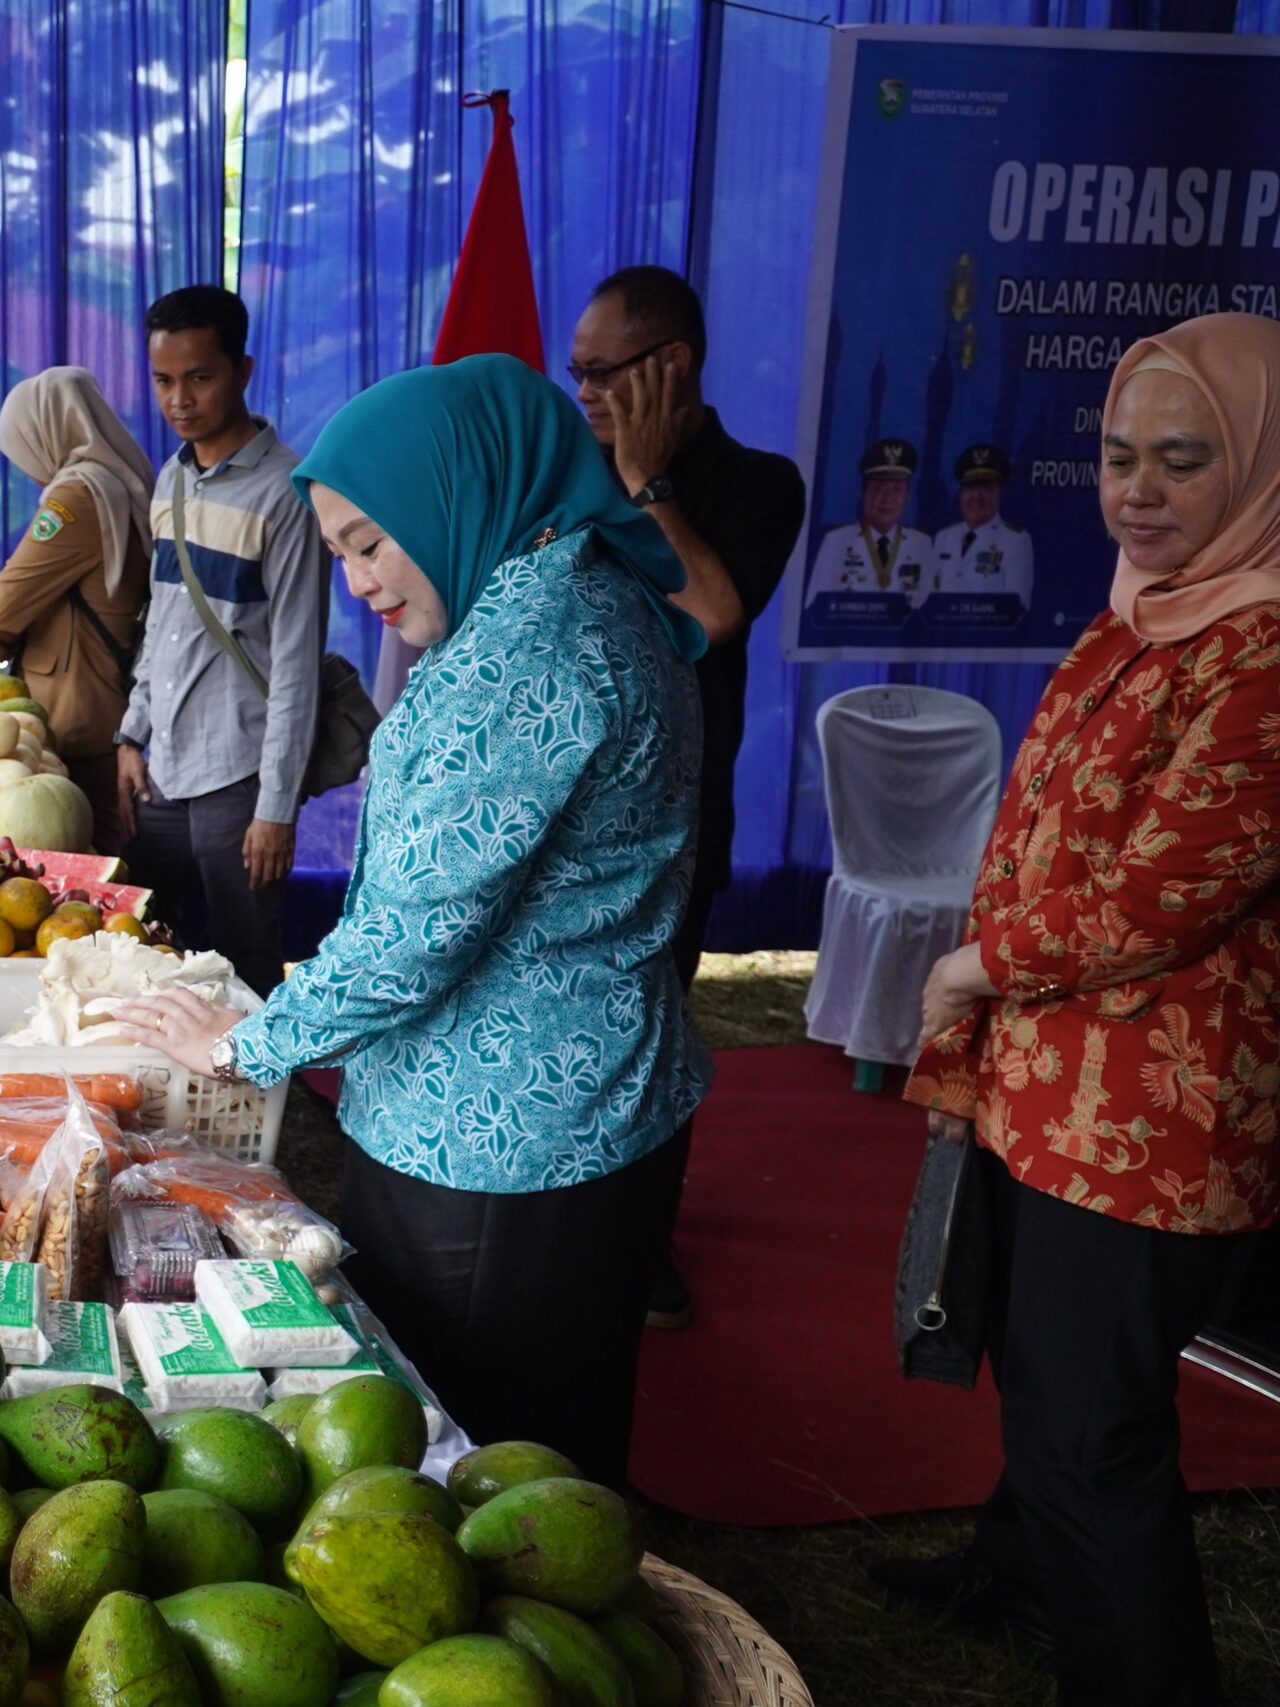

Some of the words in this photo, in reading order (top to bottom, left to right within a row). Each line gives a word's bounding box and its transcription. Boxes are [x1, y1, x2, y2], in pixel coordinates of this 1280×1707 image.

[988, 160, 1231, 248] OPERASI
[1241, 170, 1280, 249] P
[996, 279, 1097, 316] DALAM
[1105, 281, 1220, 317] RANGKA
[1026, 335, 1122, 370] HARGA
